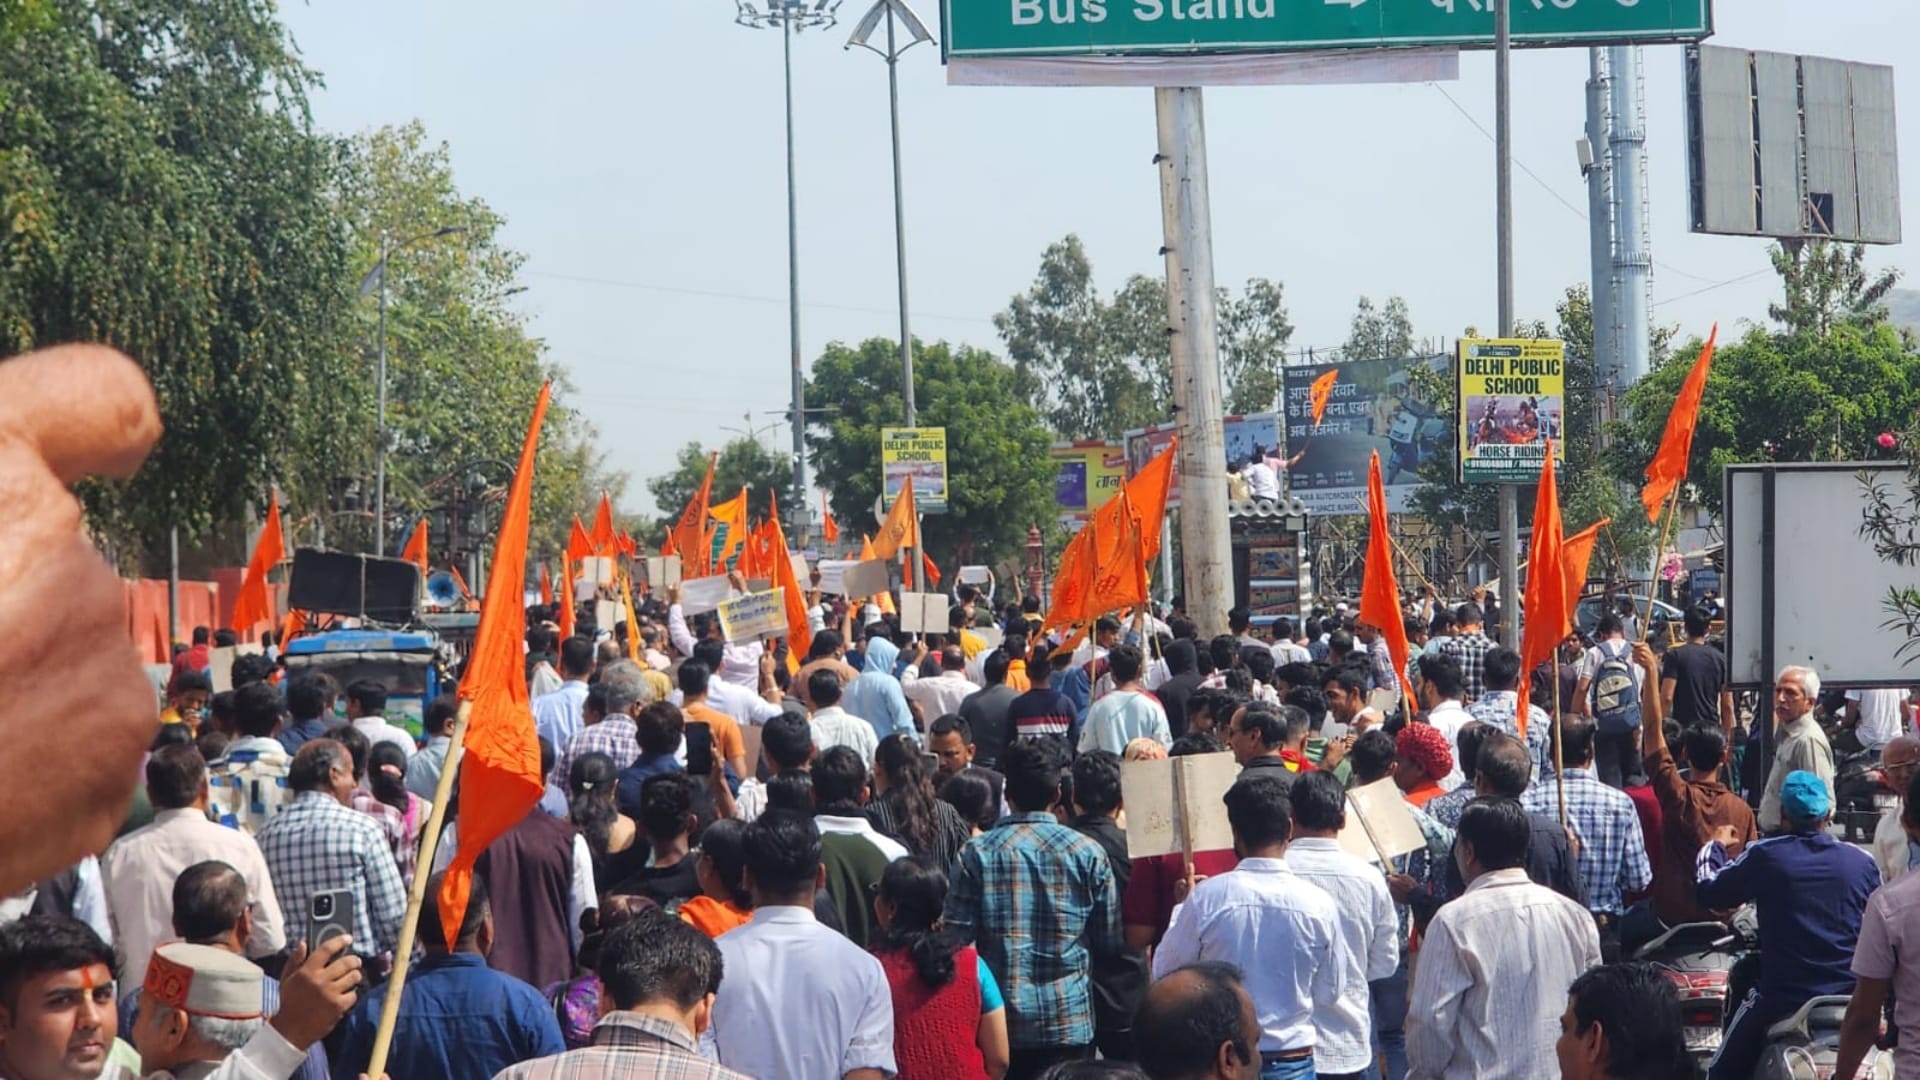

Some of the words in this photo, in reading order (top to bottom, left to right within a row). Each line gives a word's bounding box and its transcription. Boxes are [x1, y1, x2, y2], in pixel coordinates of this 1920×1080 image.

[1465, 358, 1504, 375] DELHI
[1510, 358, 1560, 375] PUBLIC
[1484, 377, 1541, 394] SCHOOL
[884, 440, 909, 450] DELHI
[912, 440, 944, 450] PUBLIC
[896, 451, 932, 461] SCHOOL
[1479, 446, 1511, 457] HORSE
